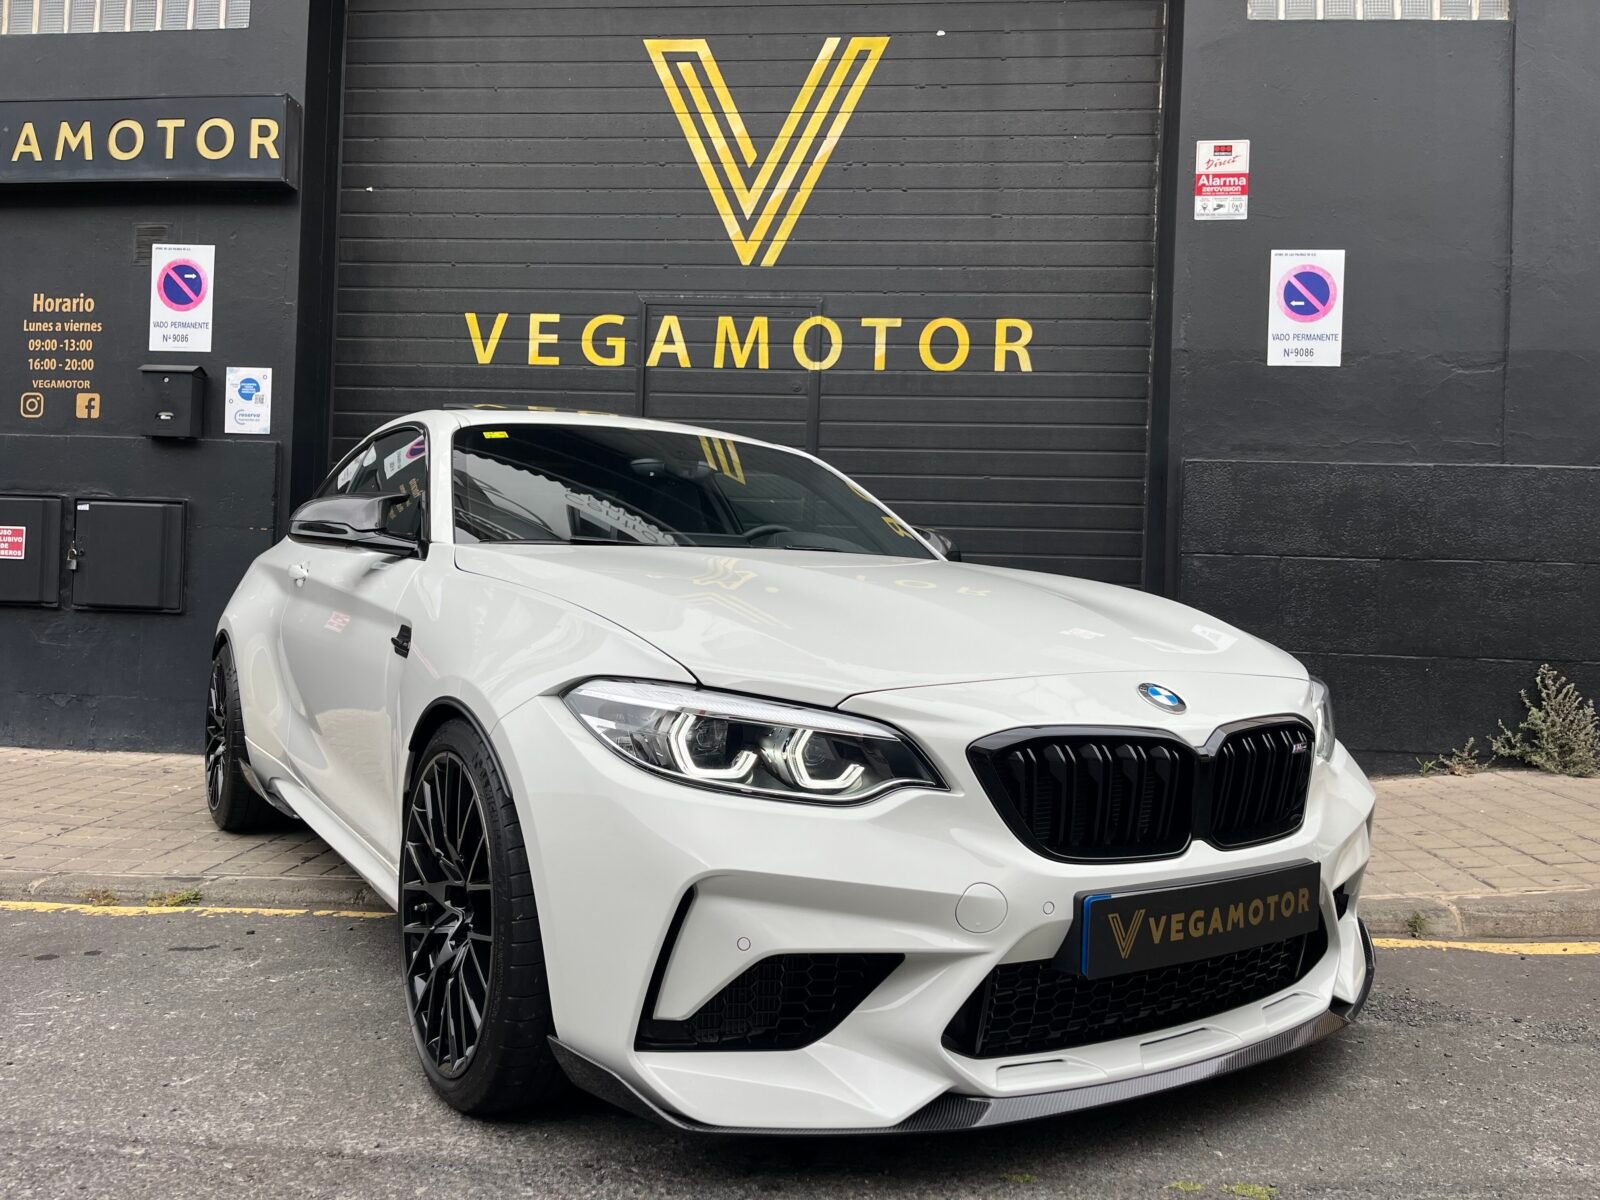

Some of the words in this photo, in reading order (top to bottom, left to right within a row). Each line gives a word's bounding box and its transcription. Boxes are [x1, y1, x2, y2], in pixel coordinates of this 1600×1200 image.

[11, 118, 281, 162] AMOTOR
[1198, 174, 1247, 186] Alarma
[32, 293, 95, 313] Horario
[23, 320, 53, 332] Lunes
[55, 322, 61, 332] a
[64, 320, 103, 332] viernes
[153, 321, 168, 329] VADO
[170, 321, 209, 330] PERMANENTE
[464, 312, 1033, 372] VEGAMOTOR
[1272, 333, 1291, 341] VADO
[1293, 333, 1339, 342] PERMANENTE
[28, 339, 57, 351] 09:00
[28, 358, 57, 371] 16:00
[64, 359, 95, 371] 20:00
[32, 379, 91, 389] VEGAMOTOR
[1149, 887, 1311, 945] VEGAMOTOR
